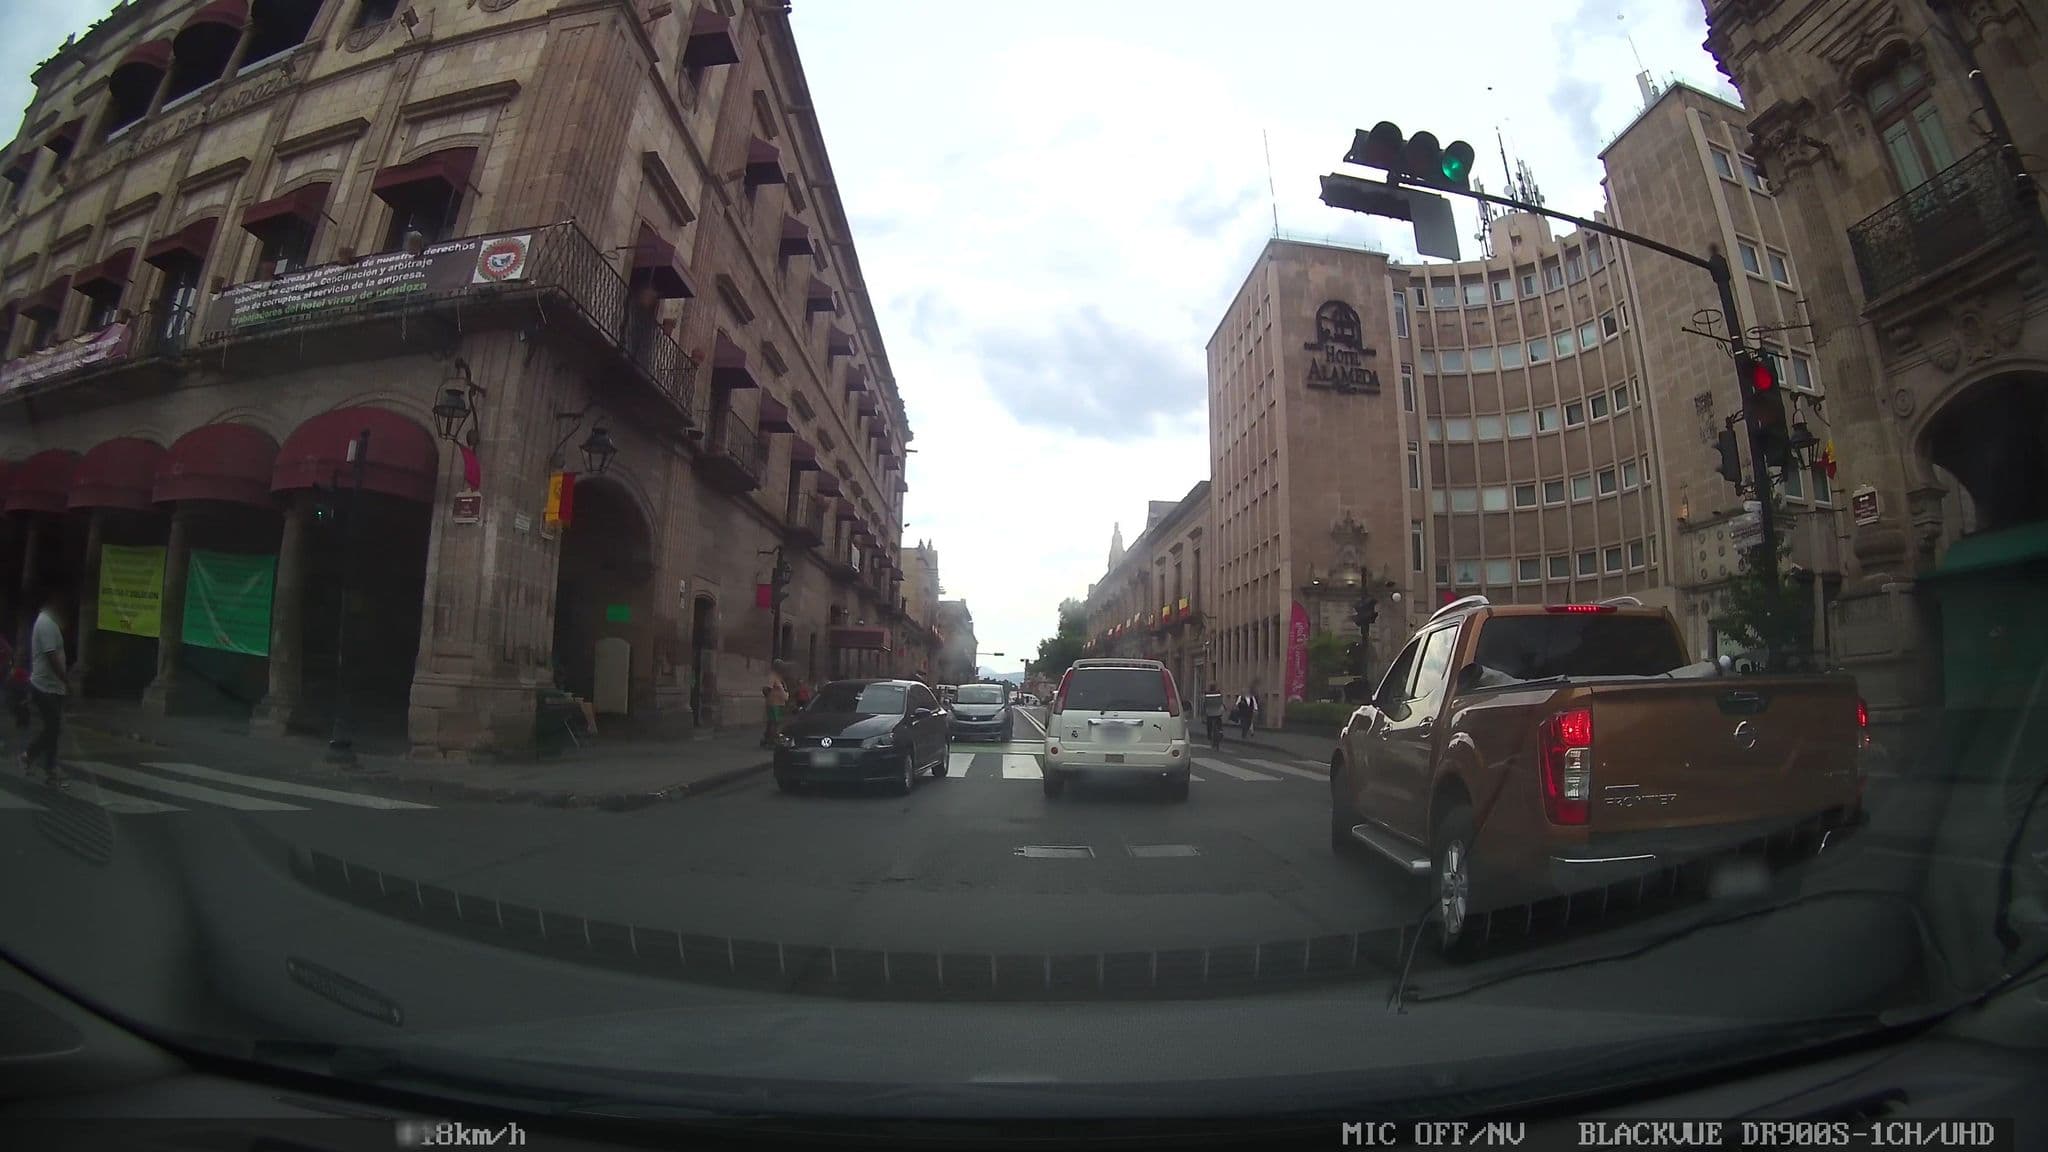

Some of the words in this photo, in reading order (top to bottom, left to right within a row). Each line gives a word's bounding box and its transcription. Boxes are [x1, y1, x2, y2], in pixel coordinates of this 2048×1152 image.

[202, 77, 287, 122] ENDOZA
[362, 259, 374, 268] de
[423, 242, 476, 256] derechos
[379, 265, 387, 276] y
[387, 257, 433, 272] arbitraje
[262, 294, 301, 308] corruptos
[303, 291, 312, 299] al
[313, 283, 349, 298] servicio
[351, 281, 363, 290] de
[365, 279, 375, 288] la
[377, 270, 426, 286] empresa.
[301, 299, 326, 312] hotel
[327, 293, 357, 306] virrey
[360, 290, 374, 300] de
[1325, 344, 1361, 366] HOTEL
[1307, 357, 1381, 386] ALAMEDA
